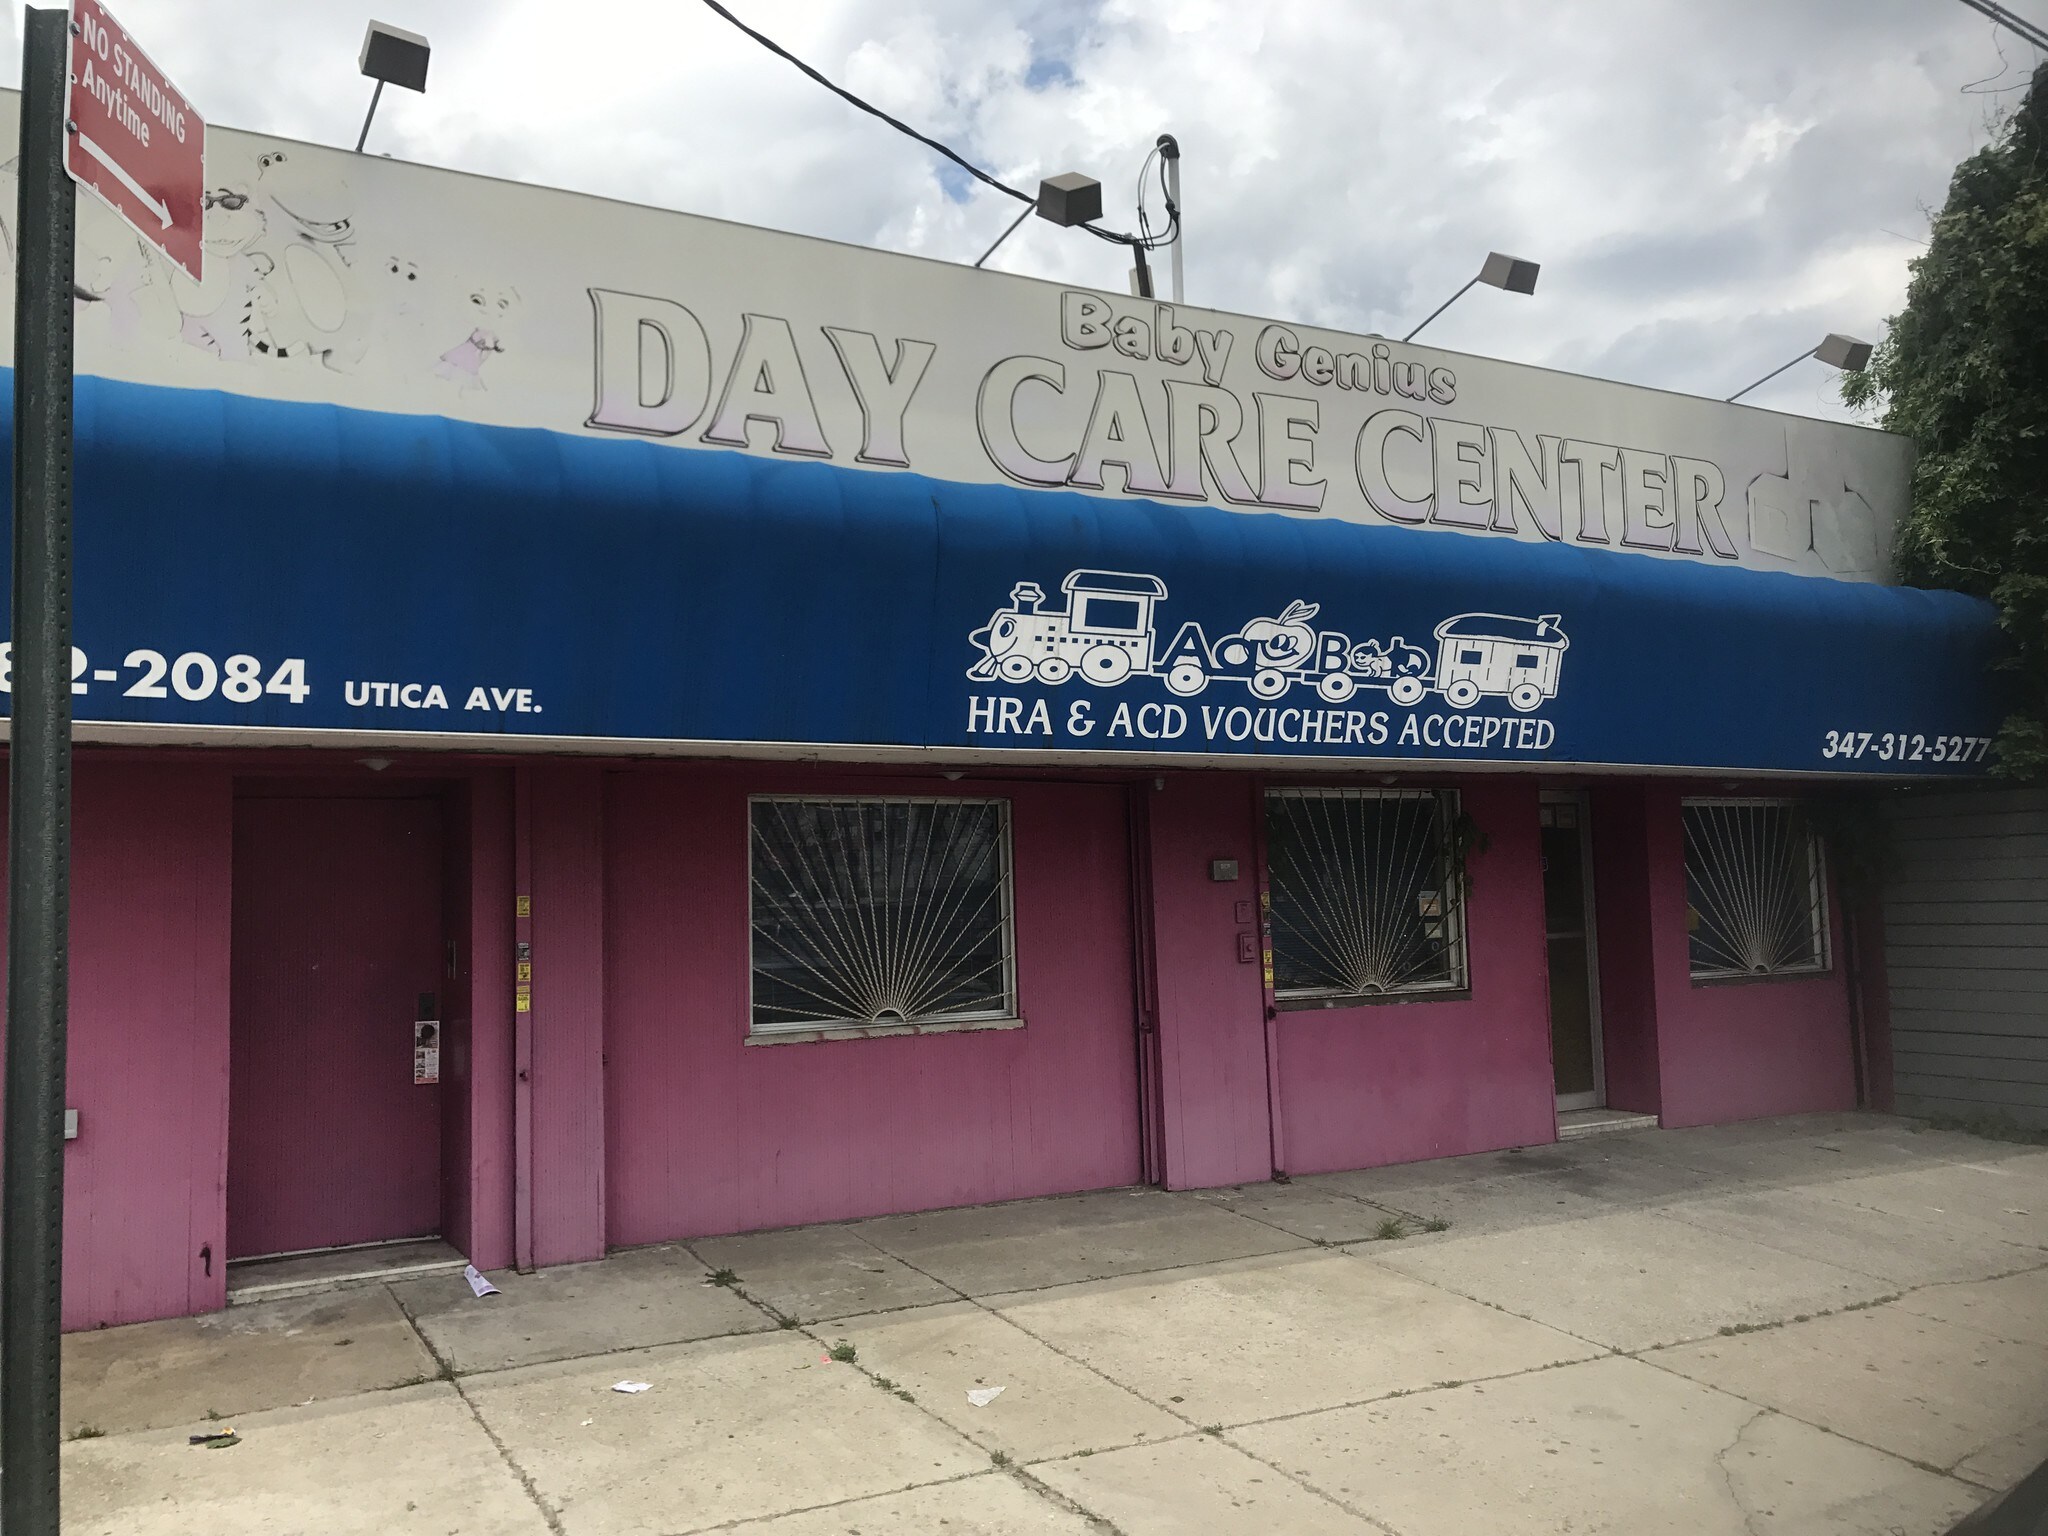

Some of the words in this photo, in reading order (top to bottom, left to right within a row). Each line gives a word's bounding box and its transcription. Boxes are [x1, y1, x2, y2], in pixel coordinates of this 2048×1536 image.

[81, 58, 150, 148] Anytime
[83, 11, 109, 61] NO
[113, 43, 186, 144] STANDING
[1061, 291, 1234, 387] Baby
[1255, 325, 1457, 405] Genius
[584, 288, 937, 468] DAY
[976, 355, 1328, 512] CARE
[1355, 409, 1739, 560] CENTER
[0, 641, 311, 704] -2084
[344, 680, 449, 709] UTICA
[464, 686, 543, 713] AVE.
[966, 696, 1053, 735] HRA
[1066, 699, 1096, 737] &
[1106, 702, 1188, 739] ACD
[1200, 705, 1390, 745] VOUCHERS
[1397, 713, 1556, 750] ACCEPTED
[1822, 730, 1992, 763] 347-312-5277
